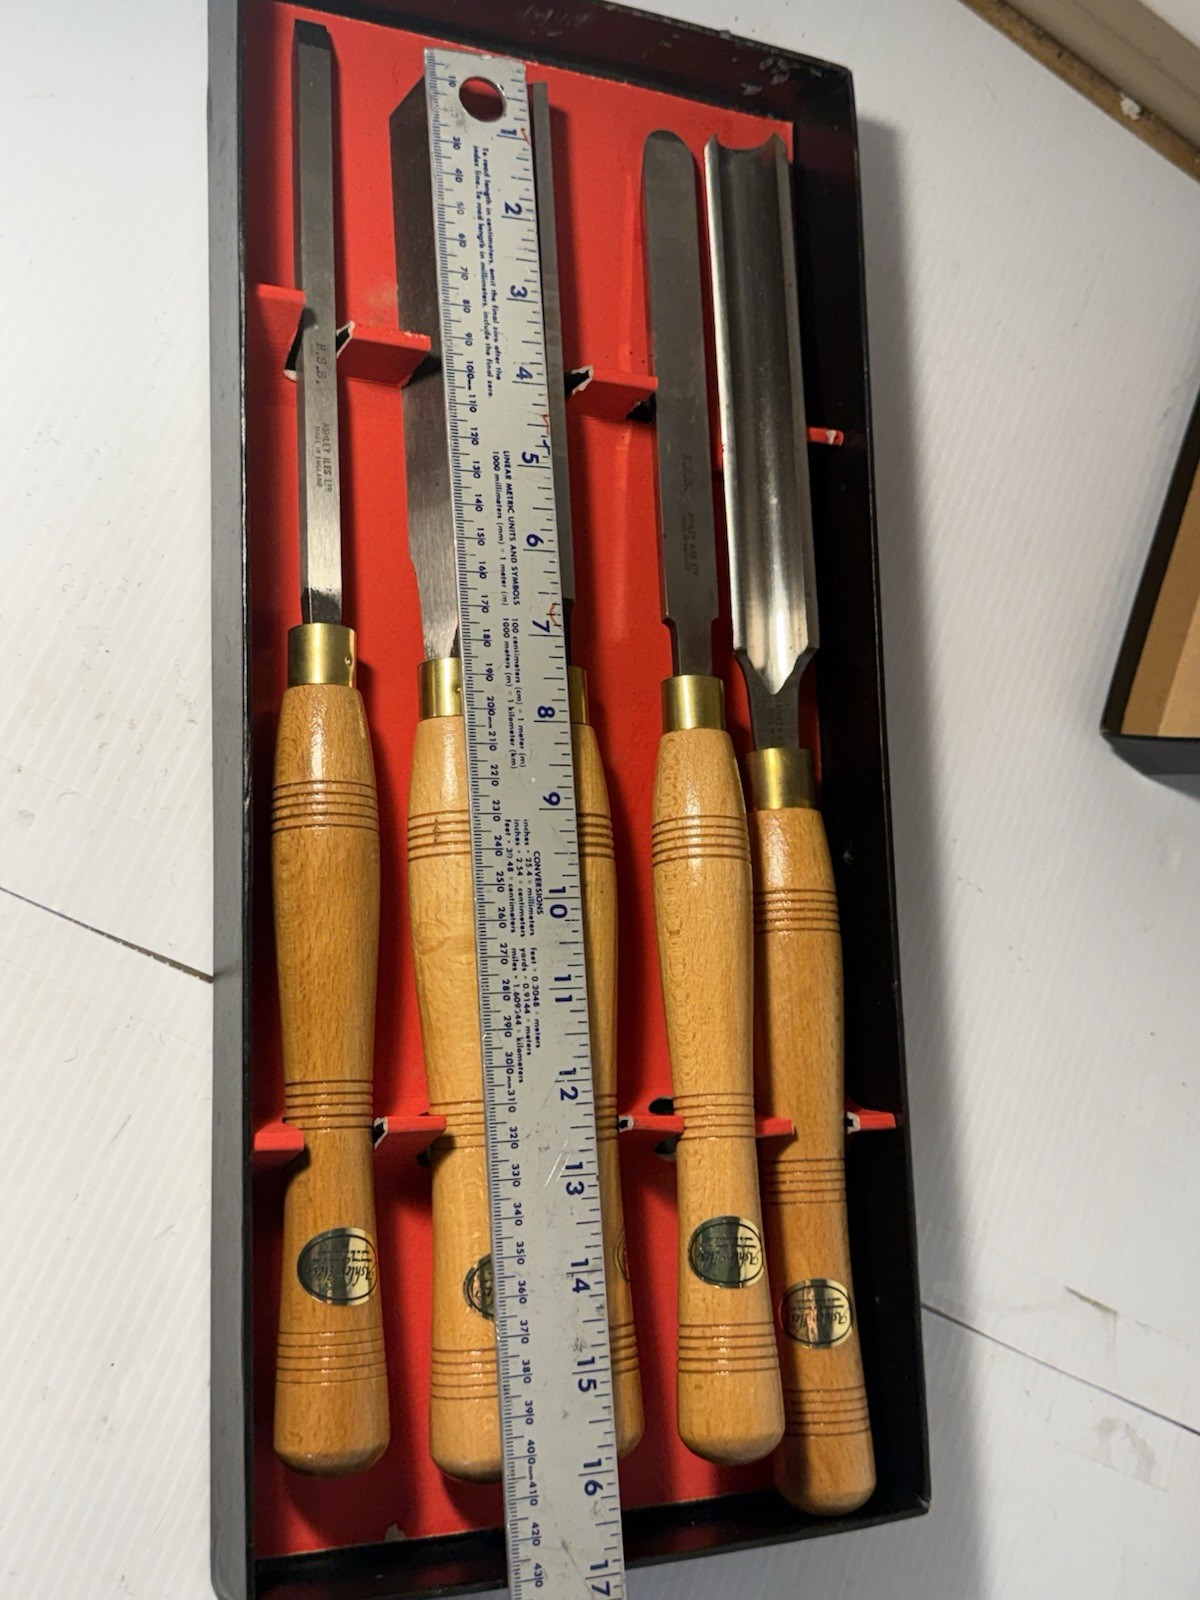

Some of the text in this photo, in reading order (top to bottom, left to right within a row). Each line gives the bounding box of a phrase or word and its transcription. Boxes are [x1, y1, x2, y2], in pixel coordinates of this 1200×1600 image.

[448, 75, 456, 88] 10
[452, 136, 460, 150] 30
[454, 167, 462, 183] 40
[456, 201, 464, 215] 50
[485, 207, 491, 215] in
[504, 201, 522, 215] 2
[458, 232, 466, 247] 60
[479, 250, 485, 259] in
[459, 266, 468, 280] 70
[509, 284, 527, 298] 3
[462, 298, 470, 313] 80
[491, 304, 499, 323] final
[481, 311, 491, 340] include
[463, 332, 472, 346] 90
[491, 345, 501, 364] after
[485, 358, 493, 377] final
[515, 366, 533, 380] 4
[467, 394, 476, 412] 110
[321, 422, 331, 453] ASHLEY
[470, 427, 479, 445] 120
[322, 457, 332, 475] ILES
[492, 451, 500, 471] 1000
[521, 451, 538, 463] 5
[315, 456, 324, 488] ENGLAND
[472, 460, 481, 478] 130
[474, 493, 483, 512] 140
[494, 473, 502, 518] millimeters
[476, 527, 485, 546] 150
[502, 450, 520, 605] LINEAR METRIC UNITS AND SYMBOLS
[526, 533, 543, 547] 6
[478, 561, 486, 579] 160
[480, 594, 489, 613] 170
[511, 618, 519, 633] 100
[532, 620, 549, 633] 7
[482, 628, 491, 647] 180
[512, 635, 520, 683] centimeters
[484, 662, 493, 681] 190
[502, 617, 510, 638] 1000
[507, 706, 515, 746] kilometer
[537, 705, 554, 718] 8
[488, 730, 496, 751] 210
[490, 764, 499, 786] 220
[542, 791, 560, 806] 9
[492, 799, 500, 821] 230
[493, 834, 502, 856] 240
[496, 870, 504, 892] 250
[513, 818, 521, 845] inches
[517, 887, 525, 937] centimeters
[532, 850, 543, 914] CONVERSIONS
[507, 883, 515, 933] centimeters
[526, 887, 534, 935] millimeters
[547, 886, 567, 918] 10
[497, 906, 507, 928] 260
[499, 942, 508, 964] 270
[518, 947, 528, 971] yards
[501, 978, 510, 1001] 280
[553, 973, 572, 1002] 11
[503, 1015, 512, 1037] 290
[511, 947, 519, 971] miles
[515, 1036, 523, 1083] kilometers
[558, 1067, 578, 1100] 12
[507, 1089, 516, 1113] 310
[509, 1126, 518, 1149] 320
[511, 1163, 521, 1187] 330
[564, 1161, 584, 1195] 13
[513, 1202, 522, 1226] 340
[515, 1241, 524, 1265] 350
[570, 1257, 590, 1293] 14
[517, 1280, 527, 1304] 360
[519, 1319, 529, 1344] 370
[521, 1359, 531, 1383] 380
[576, 1355, 597, 1392] 15
[524, 1400, 533, 1425] 390
[582, 1458, 603, 1496] 16
[529, 1480, 538, 1506] 410
[531, 1521, 541, 1546] 420
[533, 1562, 543, 1587] 430
[589, 1559, 610, 1596] 17
